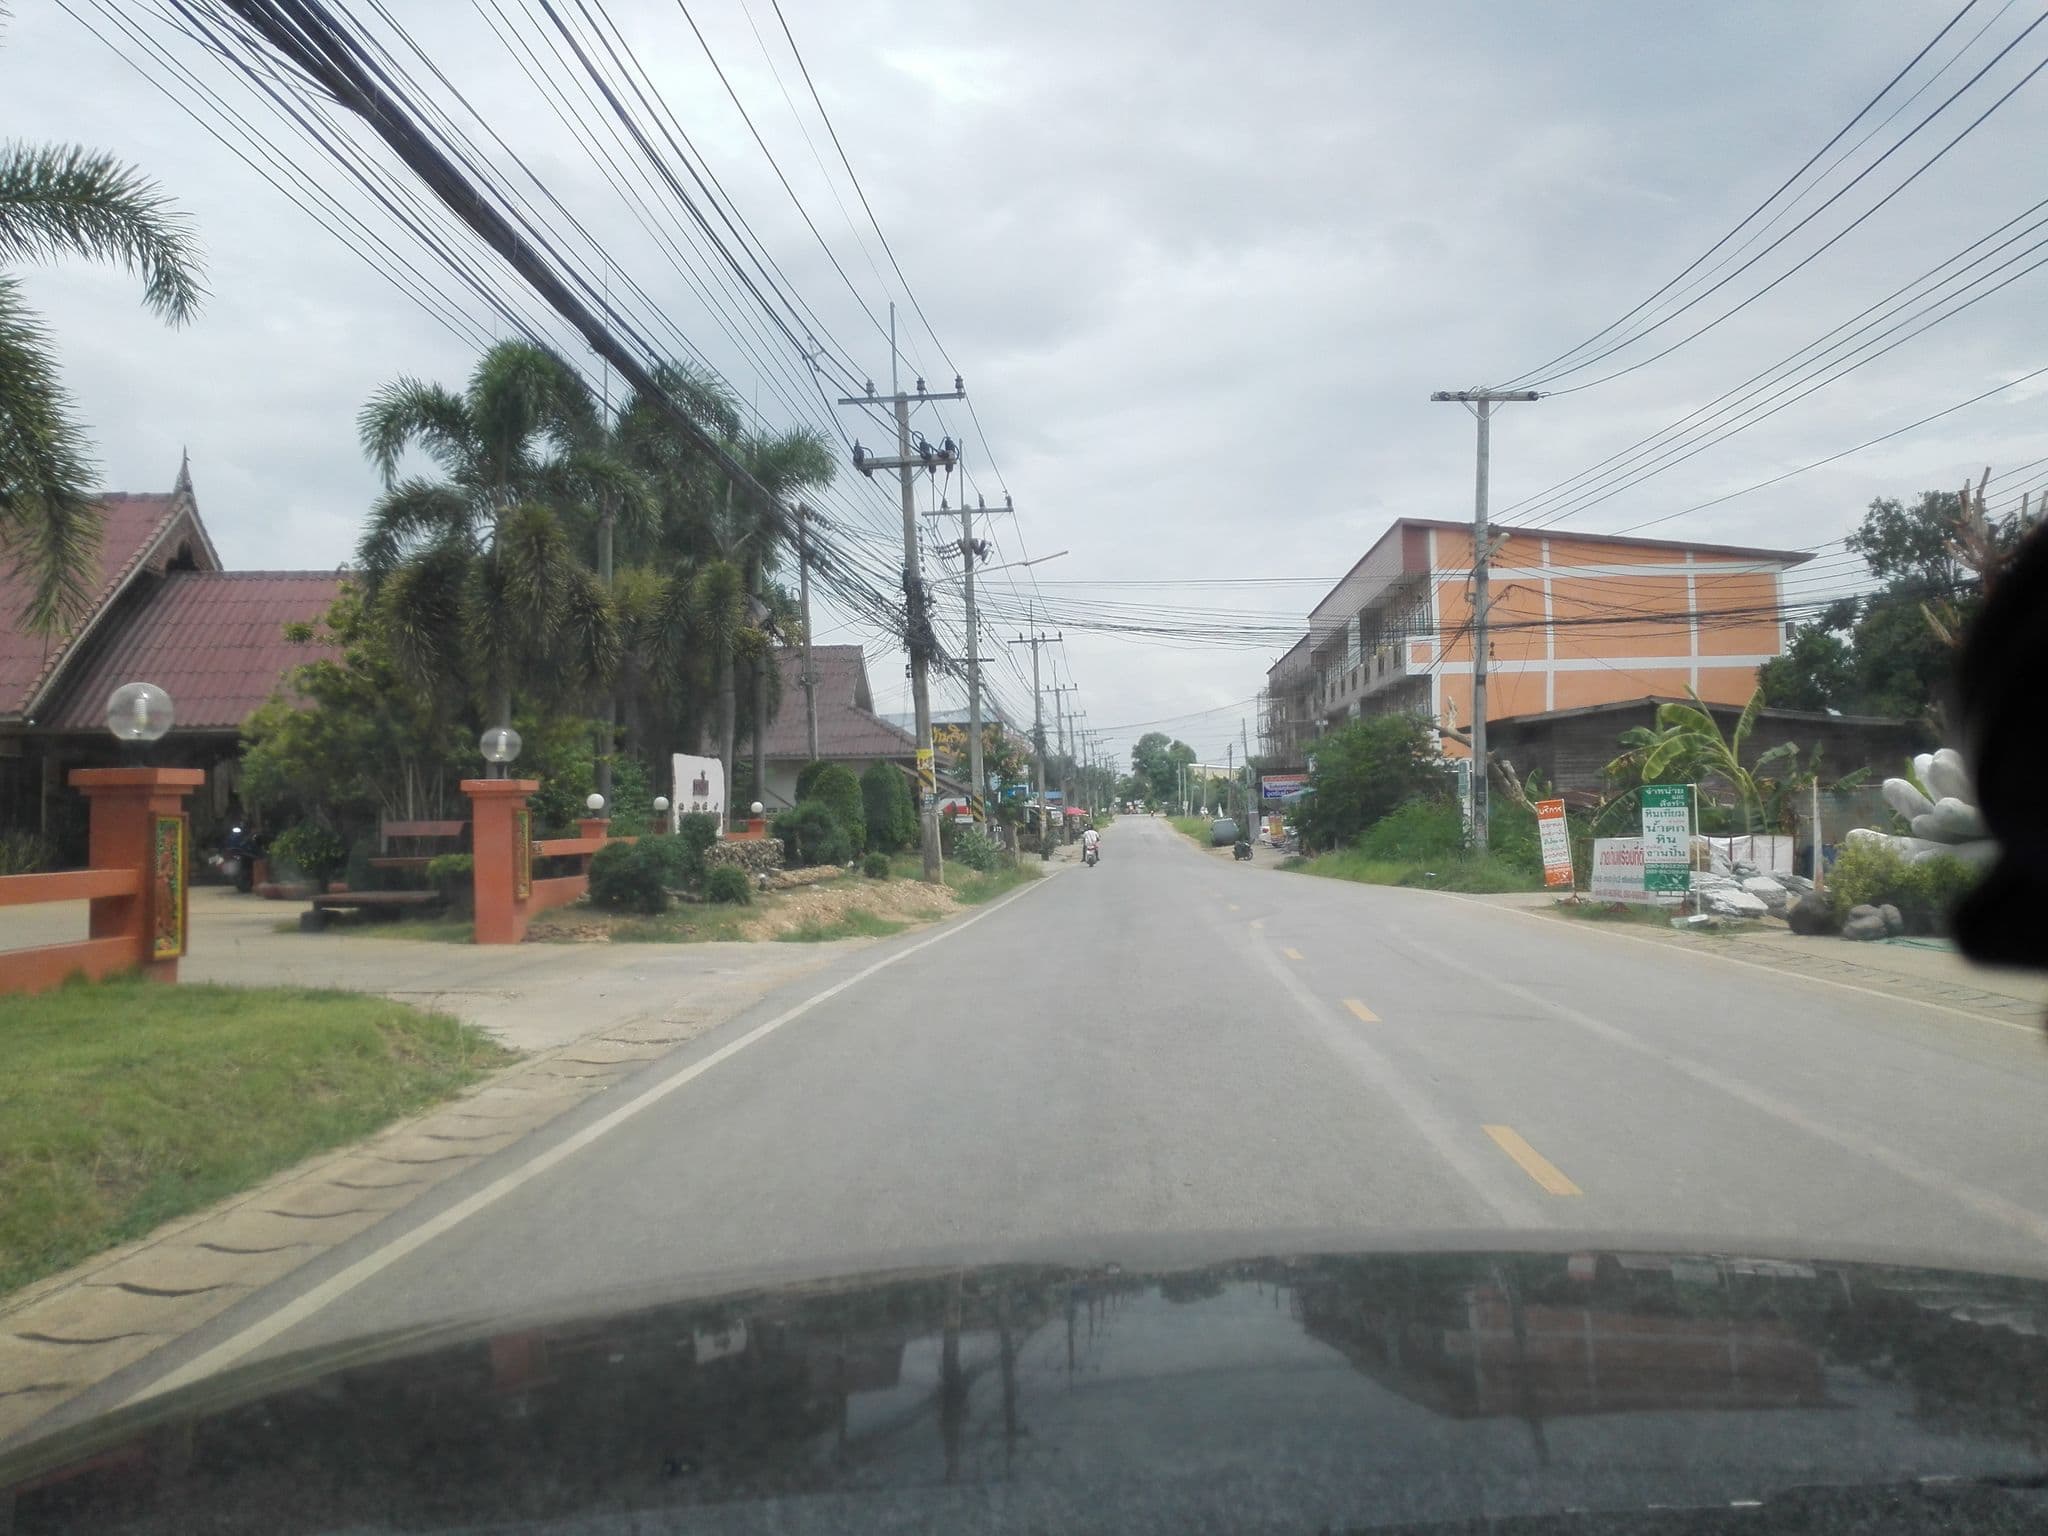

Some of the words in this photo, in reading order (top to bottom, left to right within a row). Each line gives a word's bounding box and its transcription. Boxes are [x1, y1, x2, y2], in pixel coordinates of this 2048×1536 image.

[1539, 805, 1562, 815] บริการ
[1645, 808, 1685, 818] หินเทียม
[1646, 821, 1685, 833] น้ำตก
[1656, 835, 1676, 844] หิน
